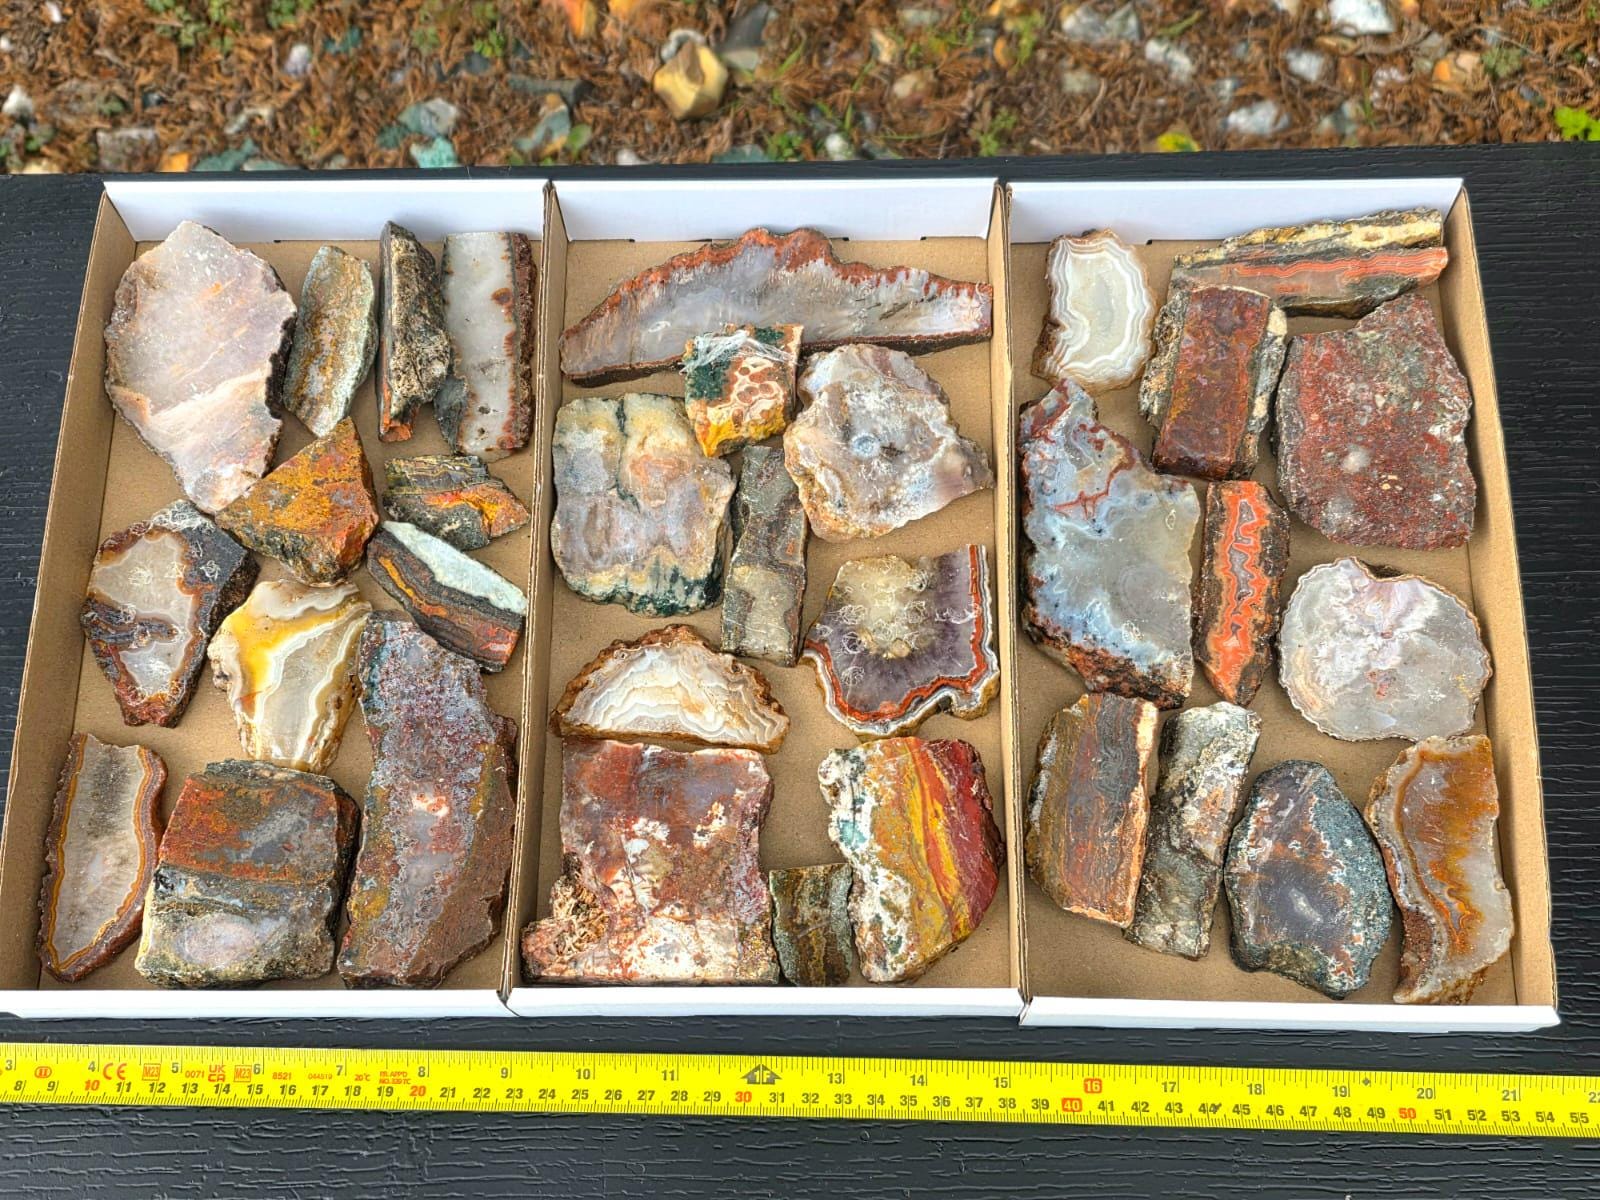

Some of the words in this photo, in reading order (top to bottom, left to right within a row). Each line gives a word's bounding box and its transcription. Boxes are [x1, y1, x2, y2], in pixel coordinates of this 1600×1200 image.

[102, 1063, 128, 1080] CE
[208, 1064, 226, 1073] UK
[184, 1070, 205, 1079] 0071
[207, 1073, 226, 1082] CA
[272, 1071, 292, 1080] 8521
[5, 1060, 13, 1071] 3
[88, 1061, 96, 1072] 4
[171, 1062, 179, 1073] 5
[253, 1063, 261, 1075] 6
[336, 1065, 343, 1076] 7
[418, 1066, 426, 1077] 8
[500, 1067, 509, 1078] 9
[576, 1068, 590, 1080] 10
[662, 1070, 675, 1081] 11
[827, 1072, 842, 1084] 13
[910, 1074, 925, 1086] 14
[994, 1077, 1008, 1088] 15
[1085, 1080, 1101, 1092] 16
[1162, 1081, 1176, 1093] 17
[1247, 1083, 1262, 1095] 18
[1332, 1085, 1348, 1097] 19
[1417, 1087, 1434, 1100] 20
[1502, 1089, 1517, 1101] 21
[1588, 1091, 1600, 1103] 2
[14, 1080, 23, 1091] 8
[47, 1081, 56, 1092] 9
[84, 1079, 100, 1091] 10
[116, 1081, 132, 1093] 11
[149, 1082, 166, 1093] 12
[182, 1082, 199, 1094] 13
[214, 1083, 231, 1094] 14
[247, 1084, 264, 1095] 15
[279, 1084, 297, 1095] 16
[312, 1085, 328, 1096] 17
[344, 1085, 362, 1096] 18
[377, 1086, 394, 1097] 19
[409, 1085, 427, 1097] 20
[439, 1087, 456, 1098] 21
[473, 1087, 491, 1099] 22
[506, 1088, 524, 1099] 23
[538, 1088, 556, 1100] 24
[571, 1089, 589, 1100] 25
[604, 1090, 623, 1101] 26
[637, 1090, 655, 1101] 27
[671, 1090, 689, 1102] 28
[703, 1091, 721, 1102] 29
[735, 1091, 752, 1103] 30
[769, 1092, 785, 1103] 31
[801, 1092, 819, 1104] 32
[834, 1093, 853, 1105] 33
[867, 1094, 885, 1106] 34
[899, 1095, 918, 1106] 35
[932, 1095, 951, 1107] 36
[965, 1097, 983, 1108] 37
[998, 1097, 1017, 1109] 38
[1031, 1098, 1050, 1110] 39
[1063, 1100, 1081, 1111] 40
[1098, 1100, 1115, 1111] 41
[1131, 1101, 1150, 1113] 42
[1165, 1102, 1183, 1114] 43
[1198, 1103, 1217, 1114] 44
[1232, 1103, 1251, 1115] 45
[1266, 1104, 1285, 1116] 46
[1299, 1105, 1318, 1117] 47
[1333, 1106, 1352, 1118] 48
[1366, 1107, 1386, 1119] 49
[1398, 1107, 1417, 1119] 50
[1434, 1108, 1452, 1120] 51
[1467, 1109, 1487, 1121] 52
[1501, 1110, 1520, 1122] 53
[1535, 1111, 1555, 1123] 54
[1569, 1112, 1590, 1124] 55
